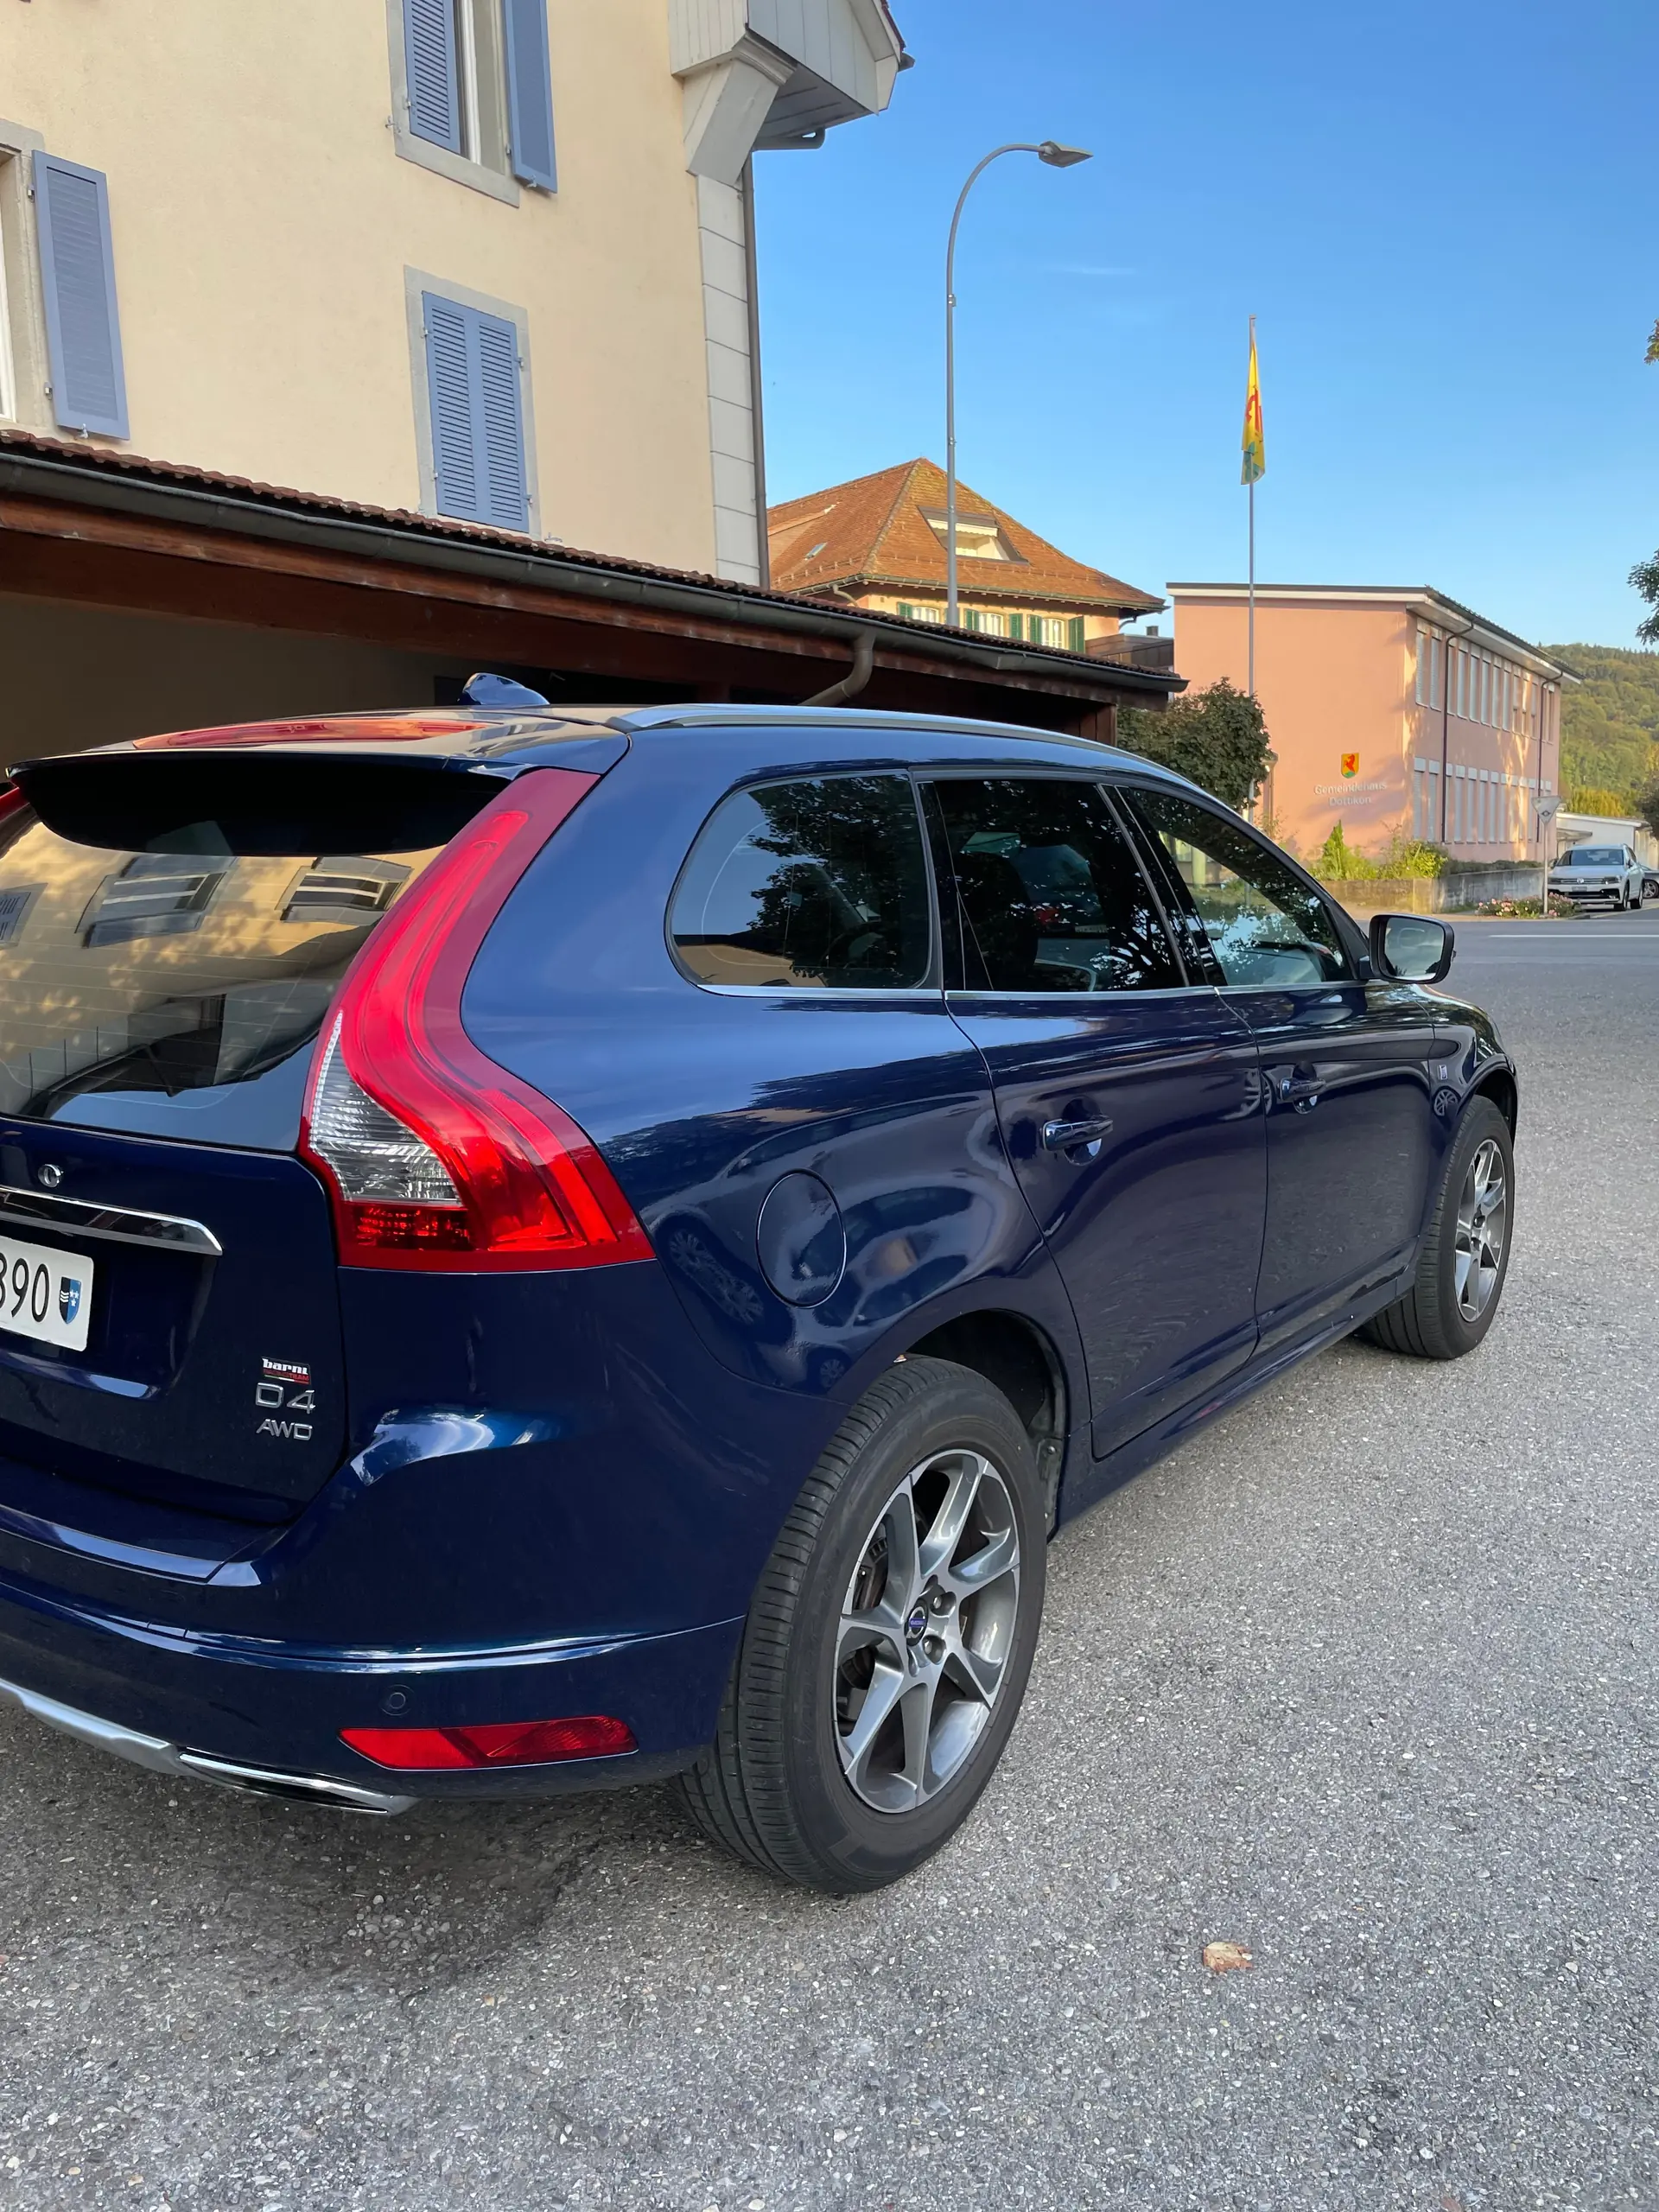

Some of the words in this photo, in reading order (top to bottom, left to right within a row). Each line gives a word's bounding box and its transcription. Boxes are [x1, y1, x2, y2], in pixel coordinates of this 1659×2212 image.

[1313, 780, 1387, 795] Gemeindehaus
[1328, 795, 1371, 806] Dottikon
[256, 1382, 315, 1414] D4
[256, 1419, 312, 1441] AWD
